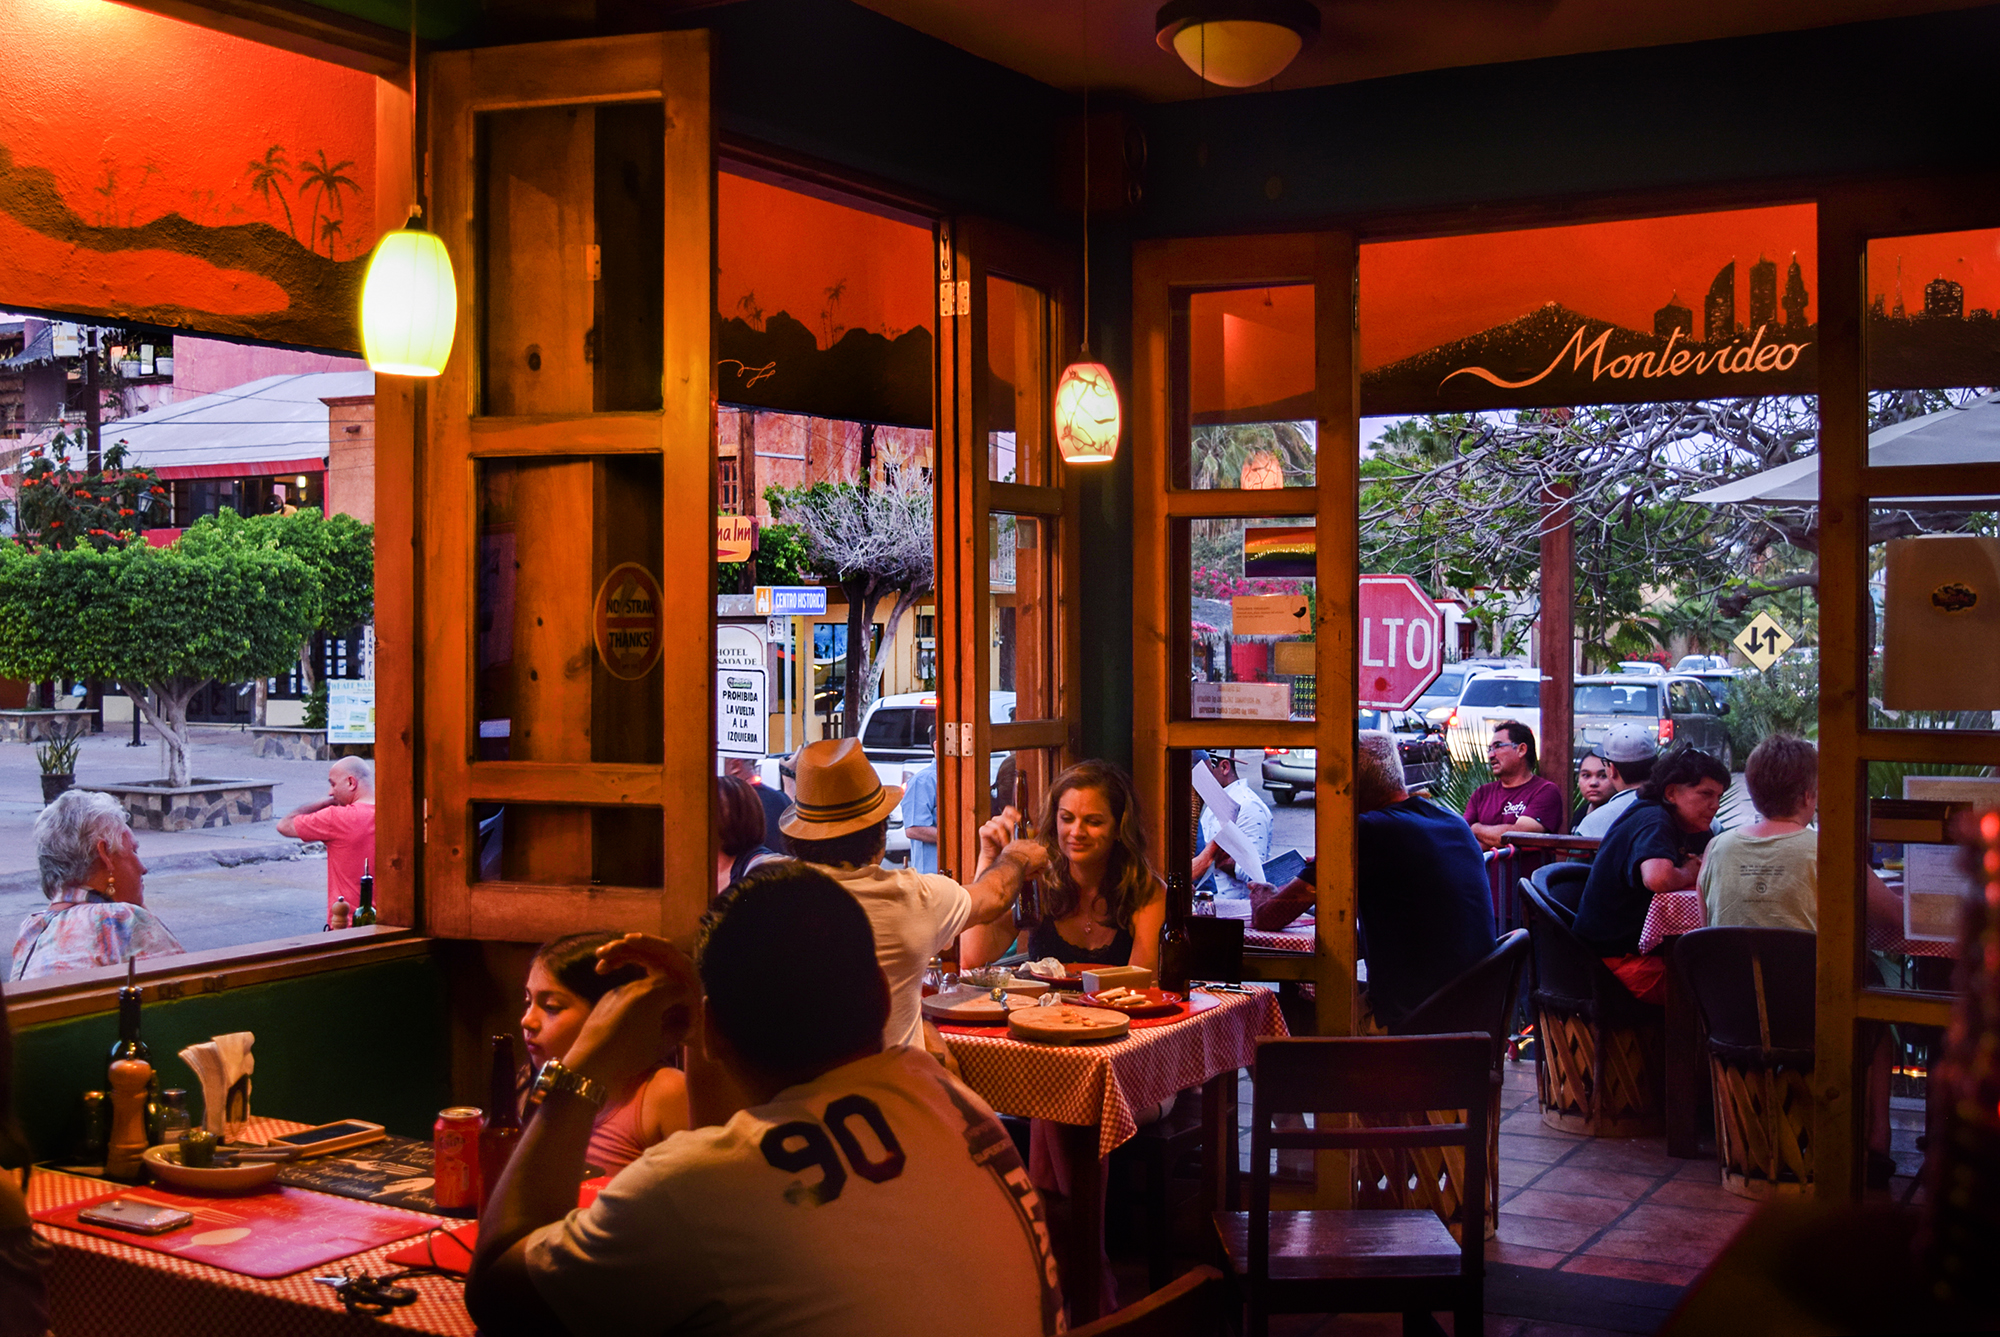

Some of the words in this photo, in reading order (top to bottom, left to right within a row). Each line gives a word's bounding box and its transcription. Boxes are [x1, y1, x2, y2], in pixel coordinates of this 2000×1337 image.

[1437, 325, 1813, 397] Montevideo
[734, 518, 751, 542] Inn
[606, 599, 620, 613] NO
[776, 592, 797, 608] CENTRO
[798, 592, 825, 608] HISTORICO
[745, 657, 757, 665] DE
[722, 690, 758, 702] PROHIBIDA
[726, 704, 734, 714] LA
[735, 706, 755, 717] VUELTA
[732, 718, 738, 727] A
[740, 718, 748, 728] LA
[727, 731, 758, 743] IZQUIERDA
[760, 1094, 906, 1207] 90
